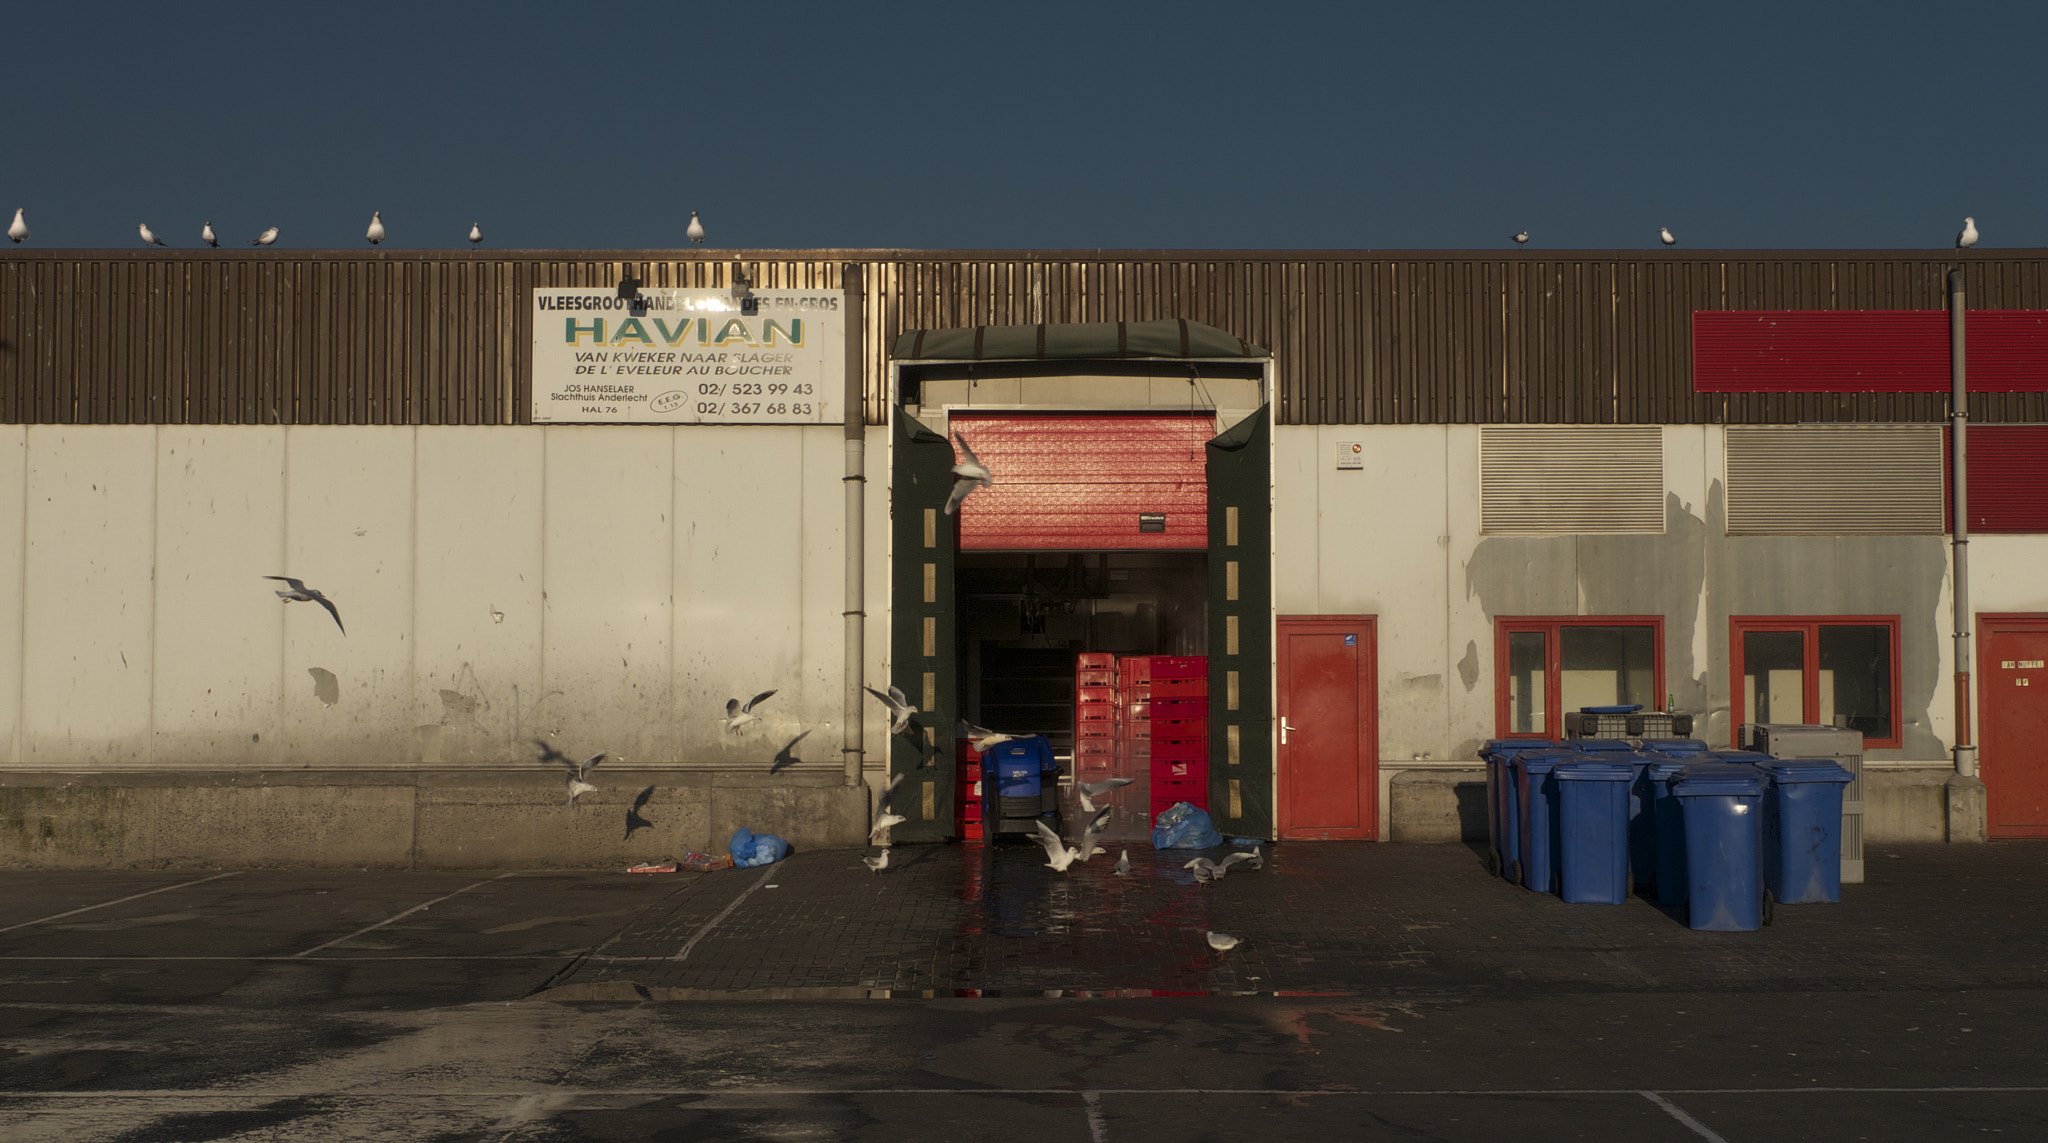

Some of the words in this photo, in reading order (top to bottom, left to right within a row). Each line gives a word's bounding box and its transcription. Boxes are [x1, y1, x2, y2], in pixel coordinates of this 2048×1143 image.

[775, 296, 794, 311] EN
[799, 296, 838, 311] GROS
[565, 317, 805, 348] HAVIAN
[575, 352, 608, 363] VAN
[612, 352, 677, 363] KWEKER
[680, 352, 728, 363] NAAR
[732, 352, 794, 363] SLAGER
[575, 365, 597, 375] DE
[616, 365, 683, 375] EVELEUR
[686, 365, 711, 375] AU
[714, 365, 793, 375] BOUCHER
[564, 384, 581, 392] JOS
[583, 385, 635, 393] HANSELAER
[698, 383, 727, 397] 02/
[732, 383, 763, 395] 523
[767, 383, 788, 395] 99
[793, 383, 813, 395] 43
[550, 392, 596, 402] Slachthuis
[598, 393, 648, 402] Anderlecht
[581, 406, 603, 414] HAL
[605, 406, 618, 414] 76
[697, 402, 726, 416] 02/
[731, 402, 761, 414] 367
[766, 403, 787, 415] 68
[792, 403, 812, 415] 83
